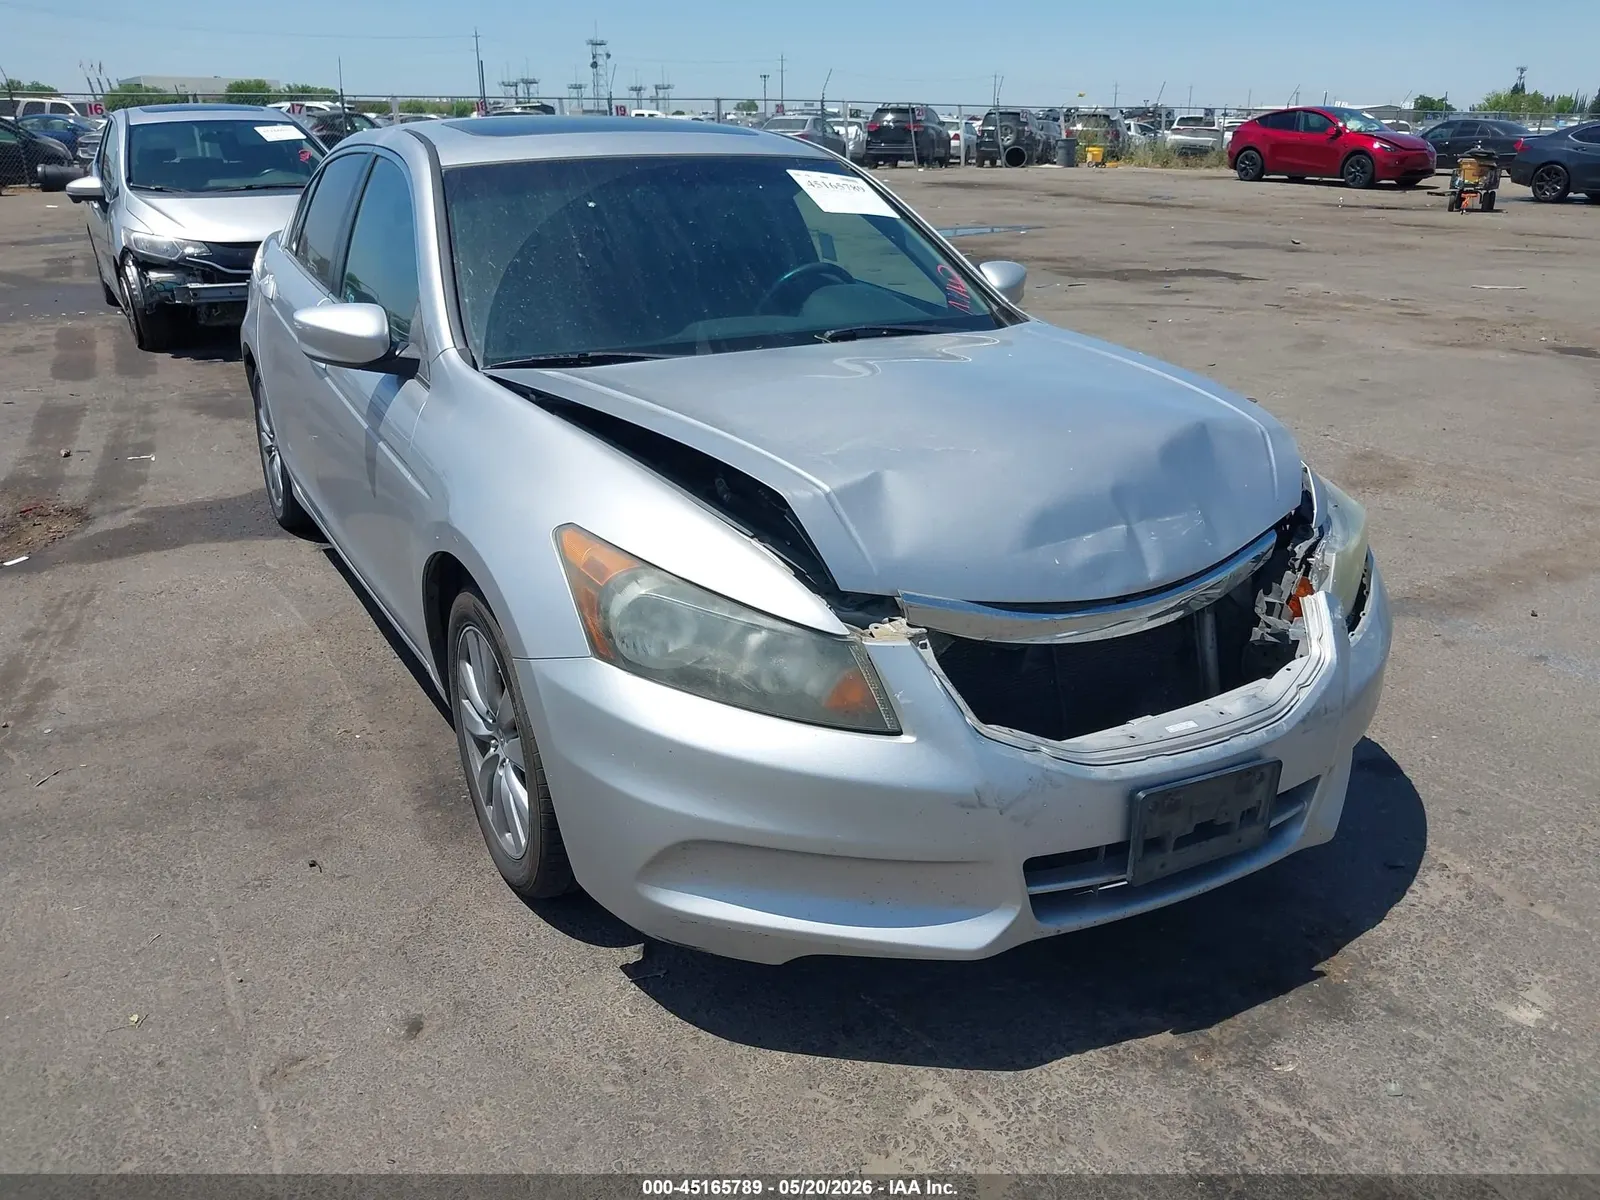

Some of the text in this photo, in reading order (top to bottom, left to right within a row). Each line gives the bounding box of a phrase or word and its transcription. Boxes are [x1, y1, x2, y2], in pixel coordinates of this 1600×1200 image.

[88, 103, 104, 115] 16
[291, 103, 305, 114] 17
[615, 104, 627, 116] 19
